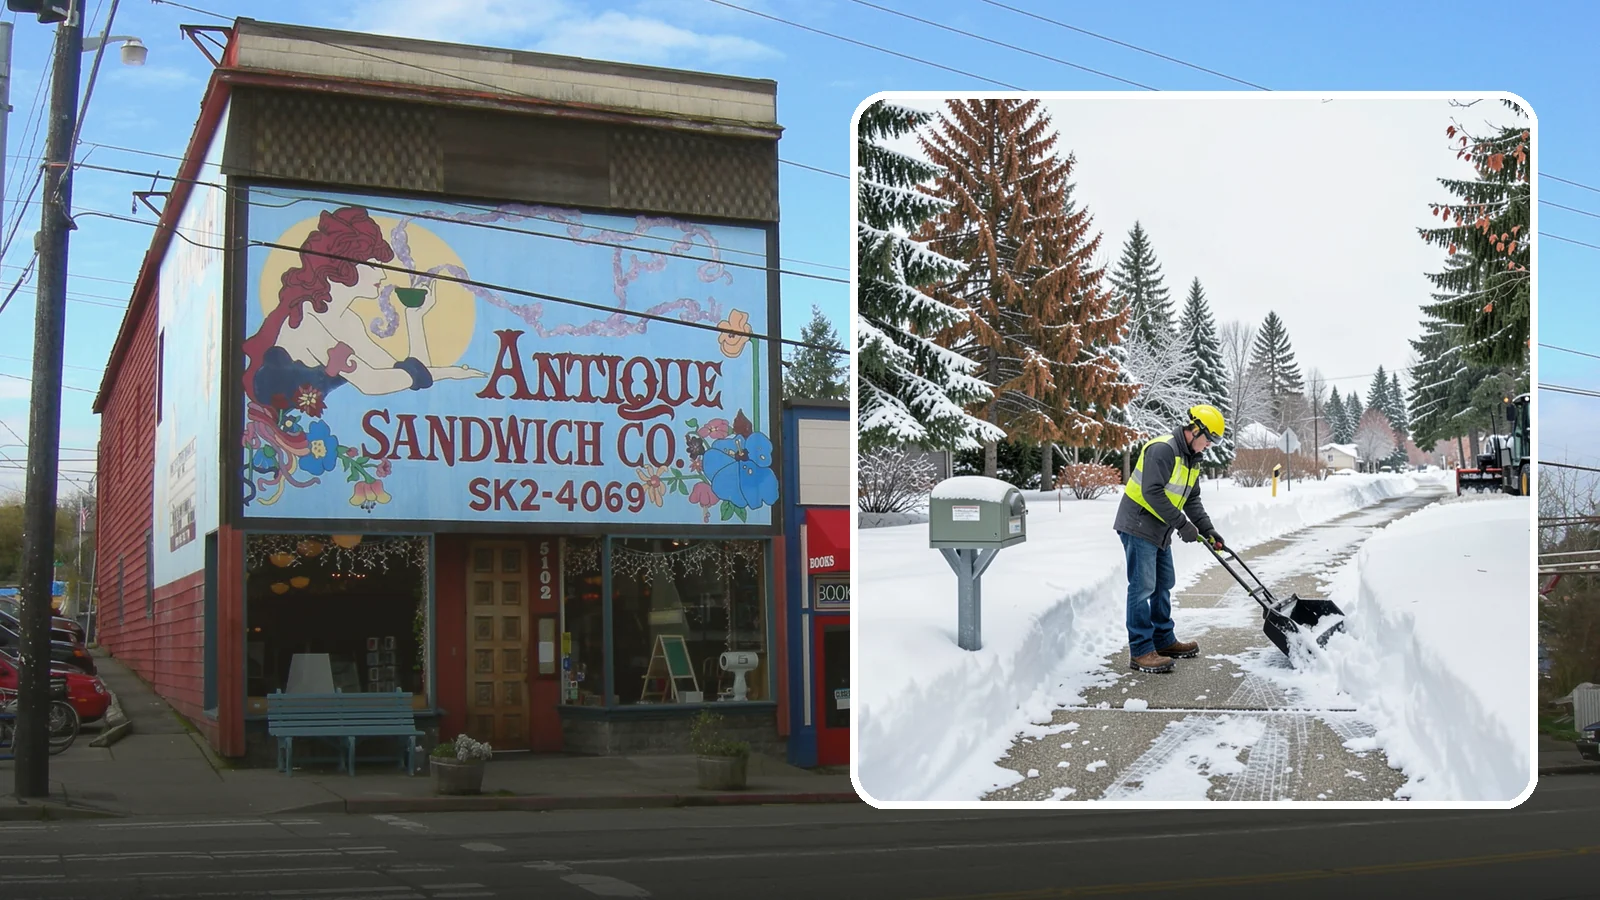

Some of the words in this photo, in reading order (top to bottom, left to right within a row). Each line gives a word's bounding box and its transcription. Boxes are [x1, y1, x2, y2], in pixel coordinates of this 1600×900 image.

[476, 329, 723, 421] ANTIQUE
[361, 409, 604, 466] SANDWICH
[616, 422, 685, 469] CO.
[469, 478, 645, 514] SK2-4069
[540, 541, 551, 600] 5102
[809, 555, 835, 569] BOOKS
